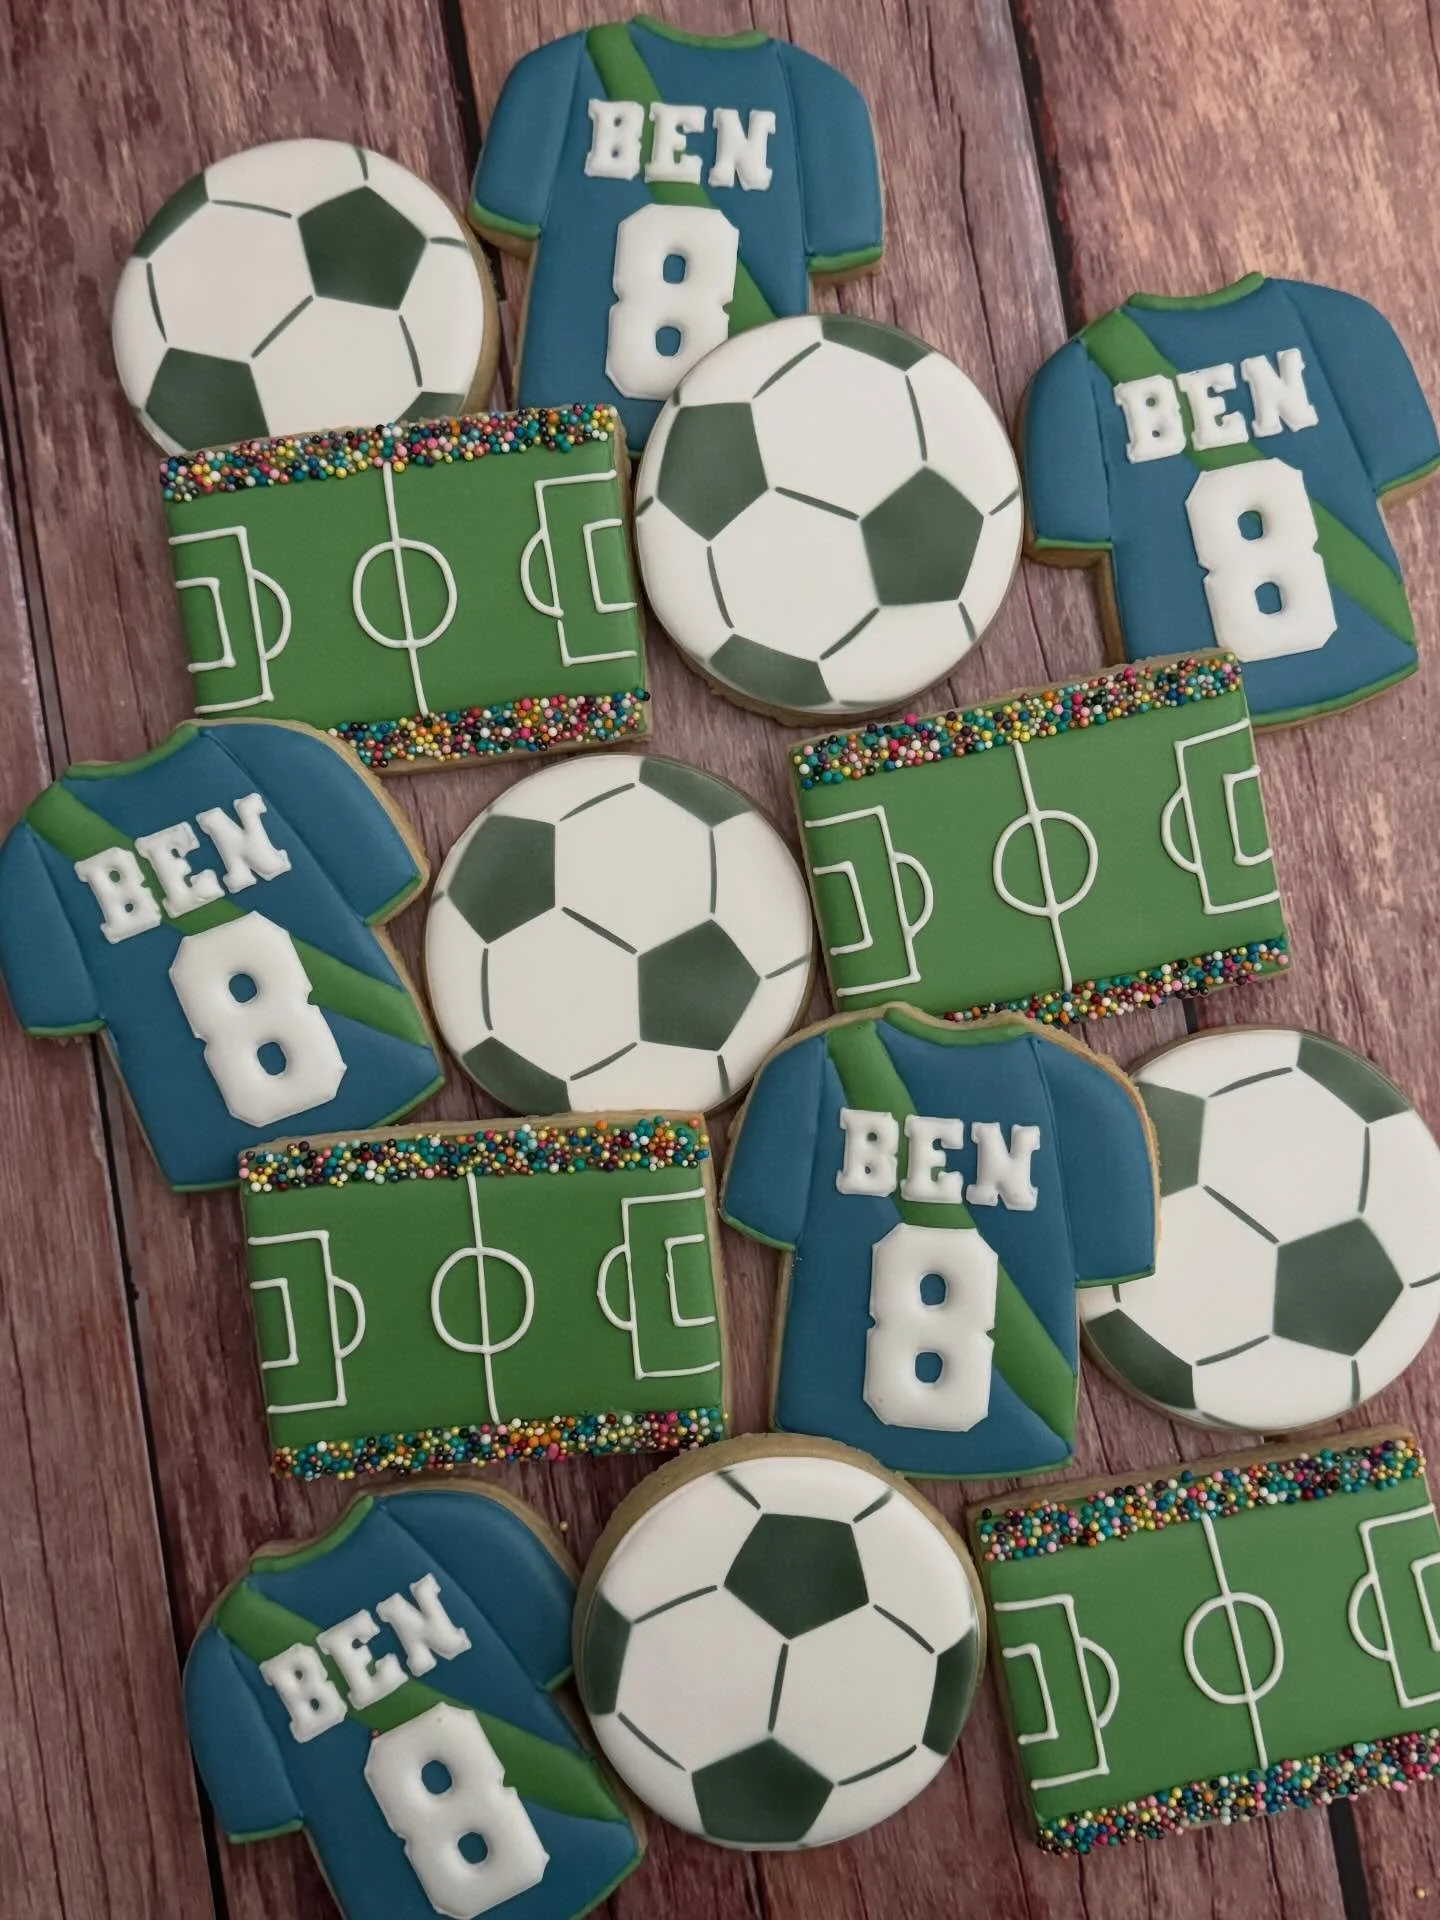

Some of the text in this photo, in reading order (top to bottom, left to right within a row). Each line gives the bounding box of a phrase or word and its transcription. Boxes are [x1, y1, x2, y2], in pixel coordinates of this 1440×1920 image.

[584, 98, 777, 192] BEN
[606, 203, 740, 400] 8
[1113, 346, 1319, 464] BEN
[1184, 457, 1337, 662] 8
[74, 792, 291, 945] BEN
[168, 910, 347, 1127] 8
[835, 1106, 1041, 1212] BEN
[863, 1222, 998, 1431] 8
[259, 1573, 471, 1743] BEN
[363, 1701, 549, 1917] 8
